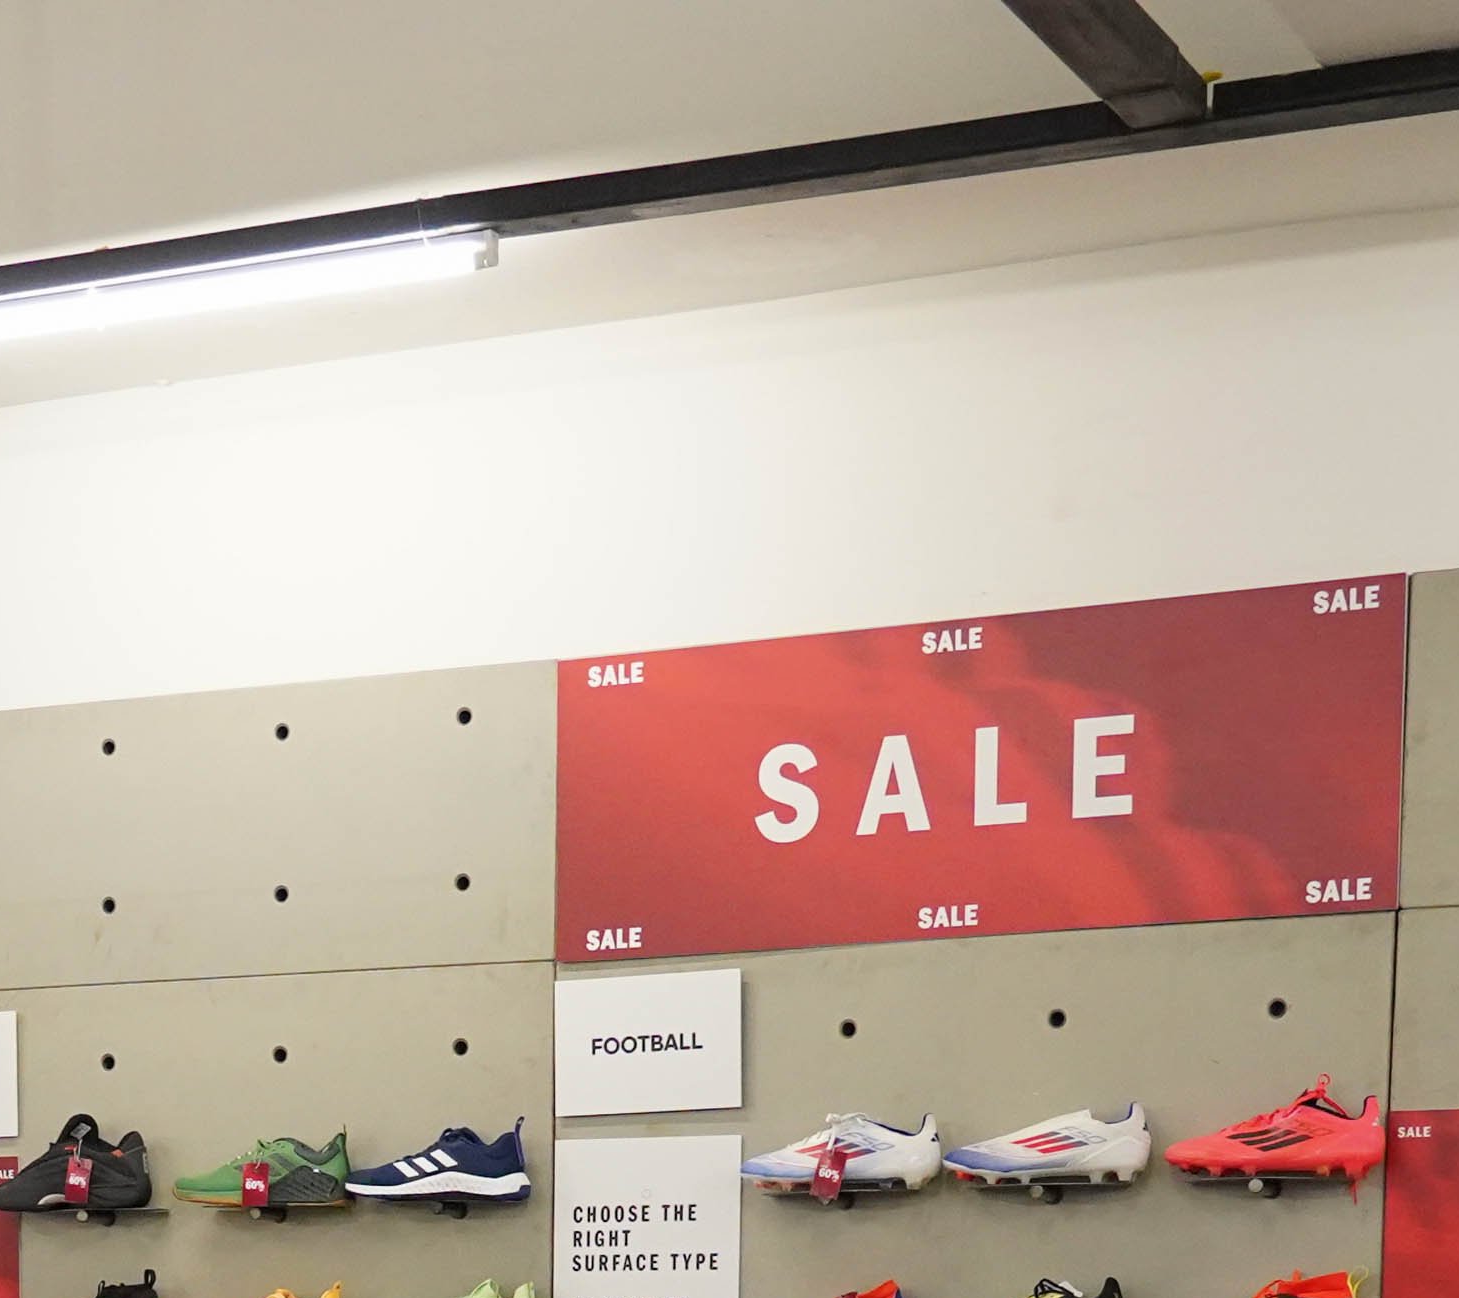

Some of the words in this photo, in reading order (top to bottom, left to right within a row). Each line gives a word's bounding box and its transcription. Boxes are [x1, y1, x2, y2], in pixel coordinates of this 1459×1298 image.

[587, 661, 644, 689] SALE
[921, 627, 983, 655] SALE
[1312, 585, 1380, 616] SALE
[754, 713, 1135, 845] SALE
[585, 926, 642, 952] SALE
[917, 903, 979, 930] SALE
[1305, 876, 1372, 905] SALE
[591, 1032, 704, 1056] FOOTBALL
[1397, 1126, 1431, 1138] SALE
[819, 1168, 840, 1182] 60%
[245, 1180, 265, 1191] 60%
[572, 1205, 650, 1223] CHOOSE
[661, 1204, 697, 1222] THE
[572, 1230, 631, 1248] RIGHT
[572, 1253, 659, 1272] SURFACE
[670, 1253, 719, 1271] TYPE
